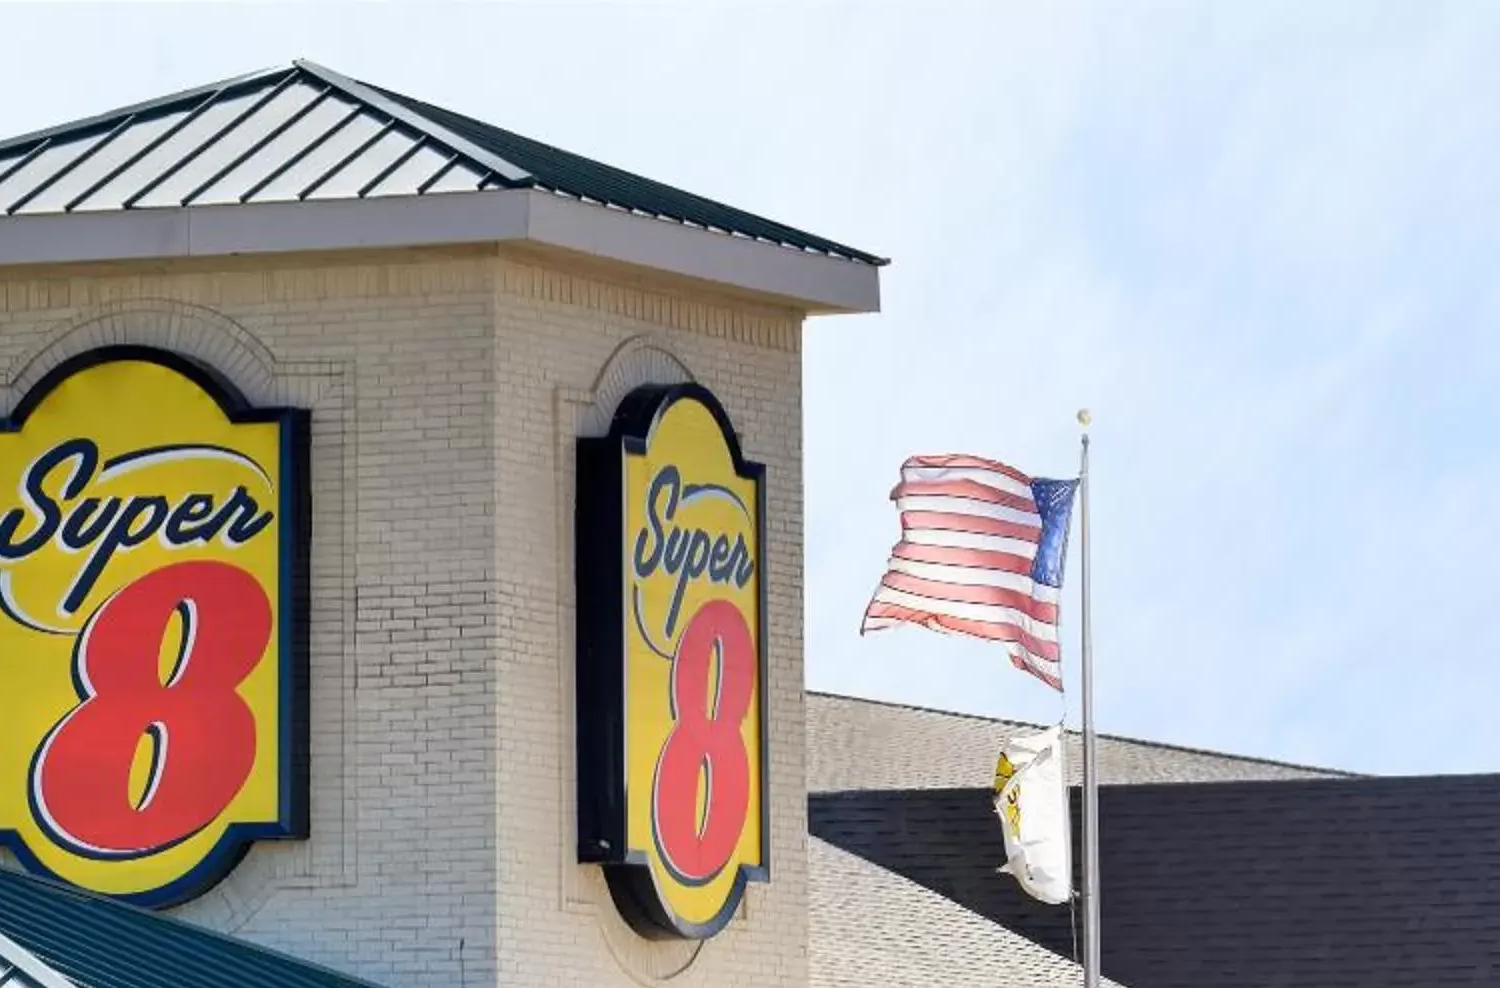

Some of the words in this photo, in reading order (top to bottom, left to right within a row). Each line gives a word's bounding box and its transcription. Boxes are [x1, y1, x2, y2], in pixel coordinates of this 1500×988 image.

[633, 464, 756, 640] Super
[27, 559, 274, 862] 8
[650, 598, 756, 887] 8
